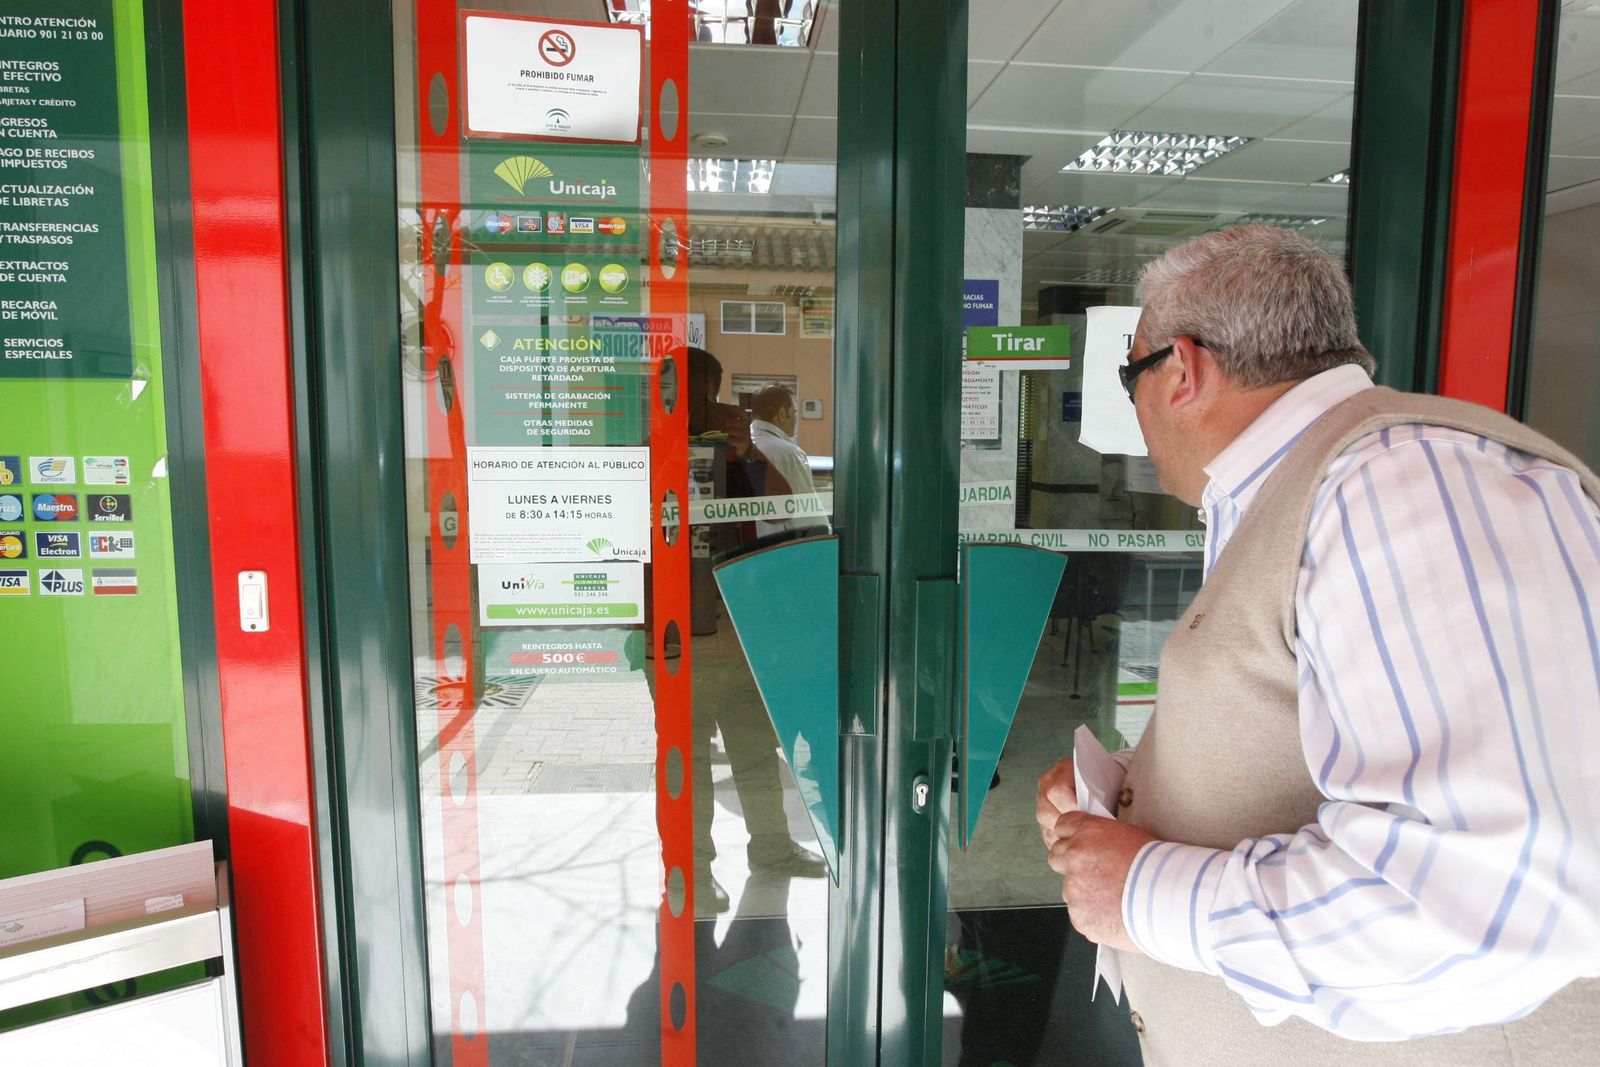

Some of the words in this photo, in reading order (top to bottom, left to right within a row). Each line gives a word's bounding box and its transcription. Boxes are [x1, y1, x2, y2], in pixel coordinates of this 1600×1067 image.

[34, 17, 96, 28] ATENCIÓN
[40, 30, 57, 39] 901
[61, 30, 72, 40] 21
[76, 31, 88, 40] 03
[91, 31, 104, 41] 00
[4, 72, 62, 82] EFECTIVO
[520, 70, 564, 80] PROHIBIDO
[566, 72, 594, 83] FUMAR
[39, 98, 76, 107] CRÉDITO
[8, 128, 58, 138] CUENTA
[26, 149, 42, 158] DE
[45, 150, 95, 160] RECIBOS
[1, 159, 68, 169] IMPUESTOS
[550, 179, 616, 199] Unicaja
[13, 198, 69, 207] LIBRETAS
[6, 235, 73, 244] TRASPASOS
[0, 261, 69, 271] EXTRACTOS
[0, 274, 14, 282] DE
[18, 274, 67, 283] CUENTA
[2, 300, 58, 310] RECARGA
[2, 311, 18, 320] DE
[21, 309, 58, 320] MÓVIL
[4, 338, 64, 348] SERVICIOS
[512, 336, 602, 350] ATENCIÓN
[992, 333, 1045, 351] Tirar
[6, 350, 72, 360] ESPECIALES
[558, 392, 611, 400] GRABACIÓN
[474, 460, 518, 469] HORARIO
[521, 461, 534, 469] DE
[536, 460, 586, 469] ATENCIÓN
[588, 461, 600, 469] AL
[602, 460, 645, 469] PÚBLICO
[508, 495, 548, 504] LUNES
[550, 495, 559, 504] A
[562, 495, 612, 504] VIERNES
[704, 500, 776, 519] GUARDIA
[784, 498, 824, 514] CIVIL
[520, 510, 543, 519] 8:30
[554, 510, 583, 519] 14:15
[1031, 533, 1068, 548] CIVIL
[1088, 534, 1110, 548] NO
[1118, 534, 1166, 548] PASAR
[612, 546, 646, 557] Unicaja
[53, 581, 83, 592] PLUS
[516, 606, 610, 618] www.unicaja.es
[524, 668, 557, 676] CAJERO
[559, 666, 617, 674] AUTOMÁTICO
